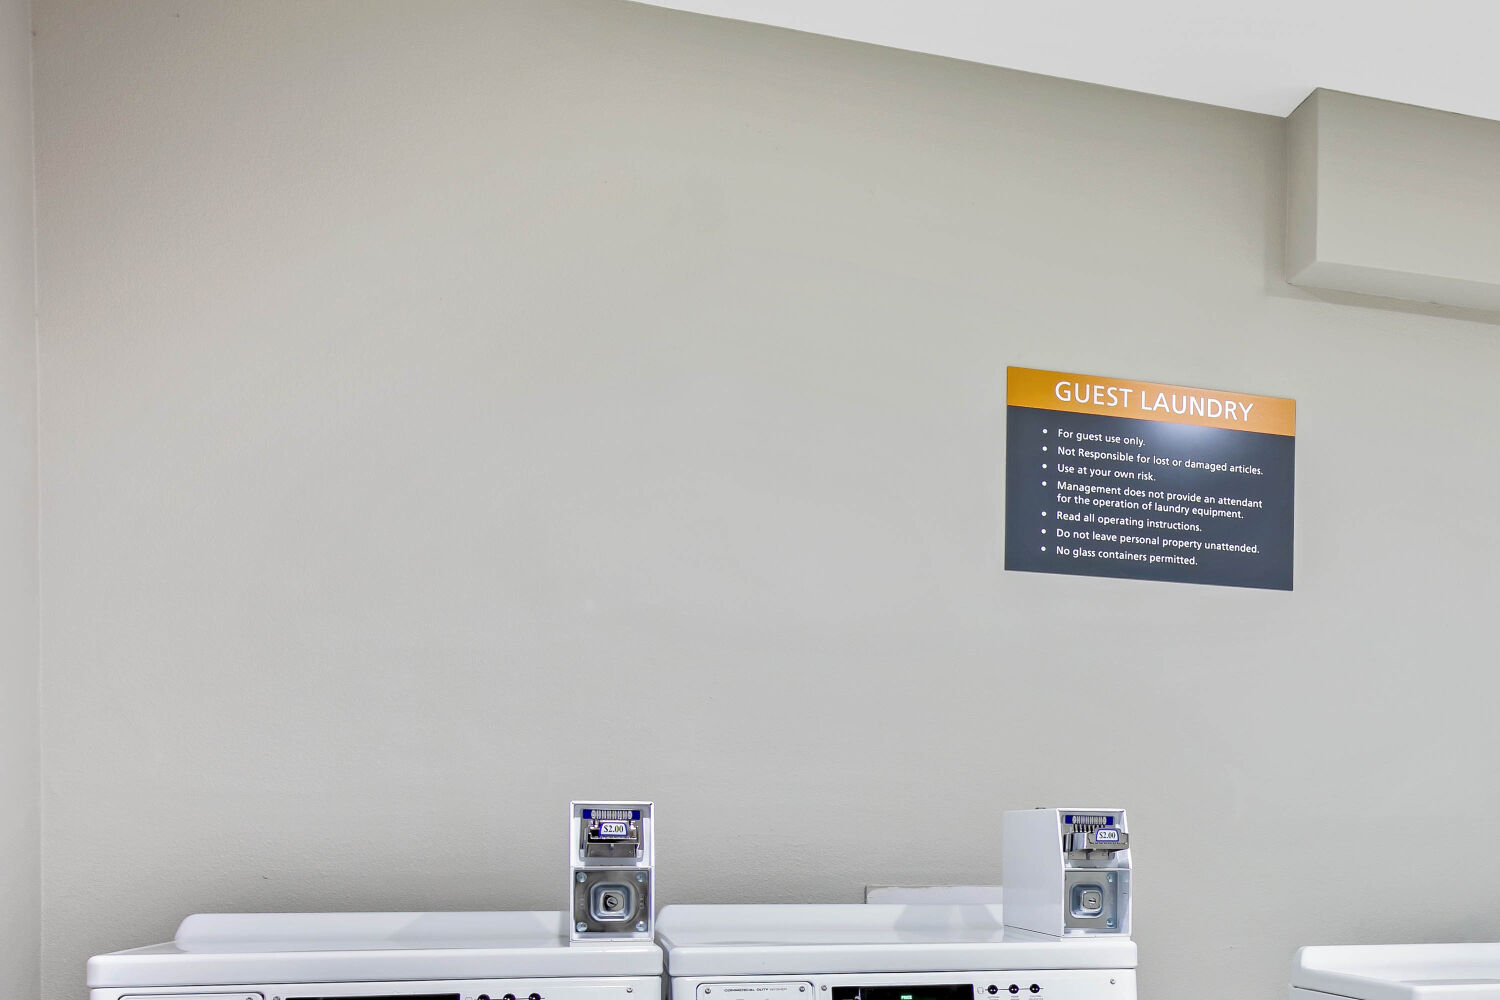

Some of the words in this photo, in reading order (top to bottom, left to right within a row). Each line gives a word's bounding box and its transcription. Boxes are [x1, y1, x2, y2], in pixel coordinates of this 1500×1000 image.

[1054, 380, 1133, 407] GUEST
[1142, 391, 1253, 421] LAUNDRY
[1058, 429, 1073, 438] For
[1076, 433, 1102, 441] guest
[1124, 437, 1145, 447] only.
[1058, 446, 1075, 456] Not
[1079, 448, 1133, 461] Responsible
[1137, 454, 1150, 463] for
[1154, 456, 1169, 465] lost
[1185, 459, 1227, 472] damaged
[1230, 465, 1263, 474] articles.
[1058, 464, 1074, 473] Use
[1090, 469, 1111, 477] your
[1138, 472, 1155, 481] risk.
[1057, 494, 1071, 503] for
[1074, 495, 1090, 504] the
[1093, 499, 1139, 509] operation
[1142, 502, 1152, 510] of
[1155, 502, 1189, 515] laundry
[1192, 507, 1243, 518] equipment.
[1058, 481, 1121, 495] Management
[1124, 487, 1145, 497] does
[1149, 491, 1164, 499] not
[1167, 493, 1201, 502] provide
[1218, 498, 1262, 508] attendant
[1057, 511, 1080, 521] Read
[1084, 514, 1094, 522] all
[1098, 517, 1143, 528] operating
[1147, 519, 1201, 531] instructions.
[1057, 529, 1070, 537] Do
[1093, 531, 1117, 541] leave
[1120, 536, 1159, 544] personal
[1163, 539, 1202, 550] property
[1205, 543, 1259, 553] unattended.
[1057, 546, 1070, 555] No
[1073, 547, 1095, 558] glass
[1098, 551, 1146, 561] containers
[1150, 555, 1197, 565] permitted.
